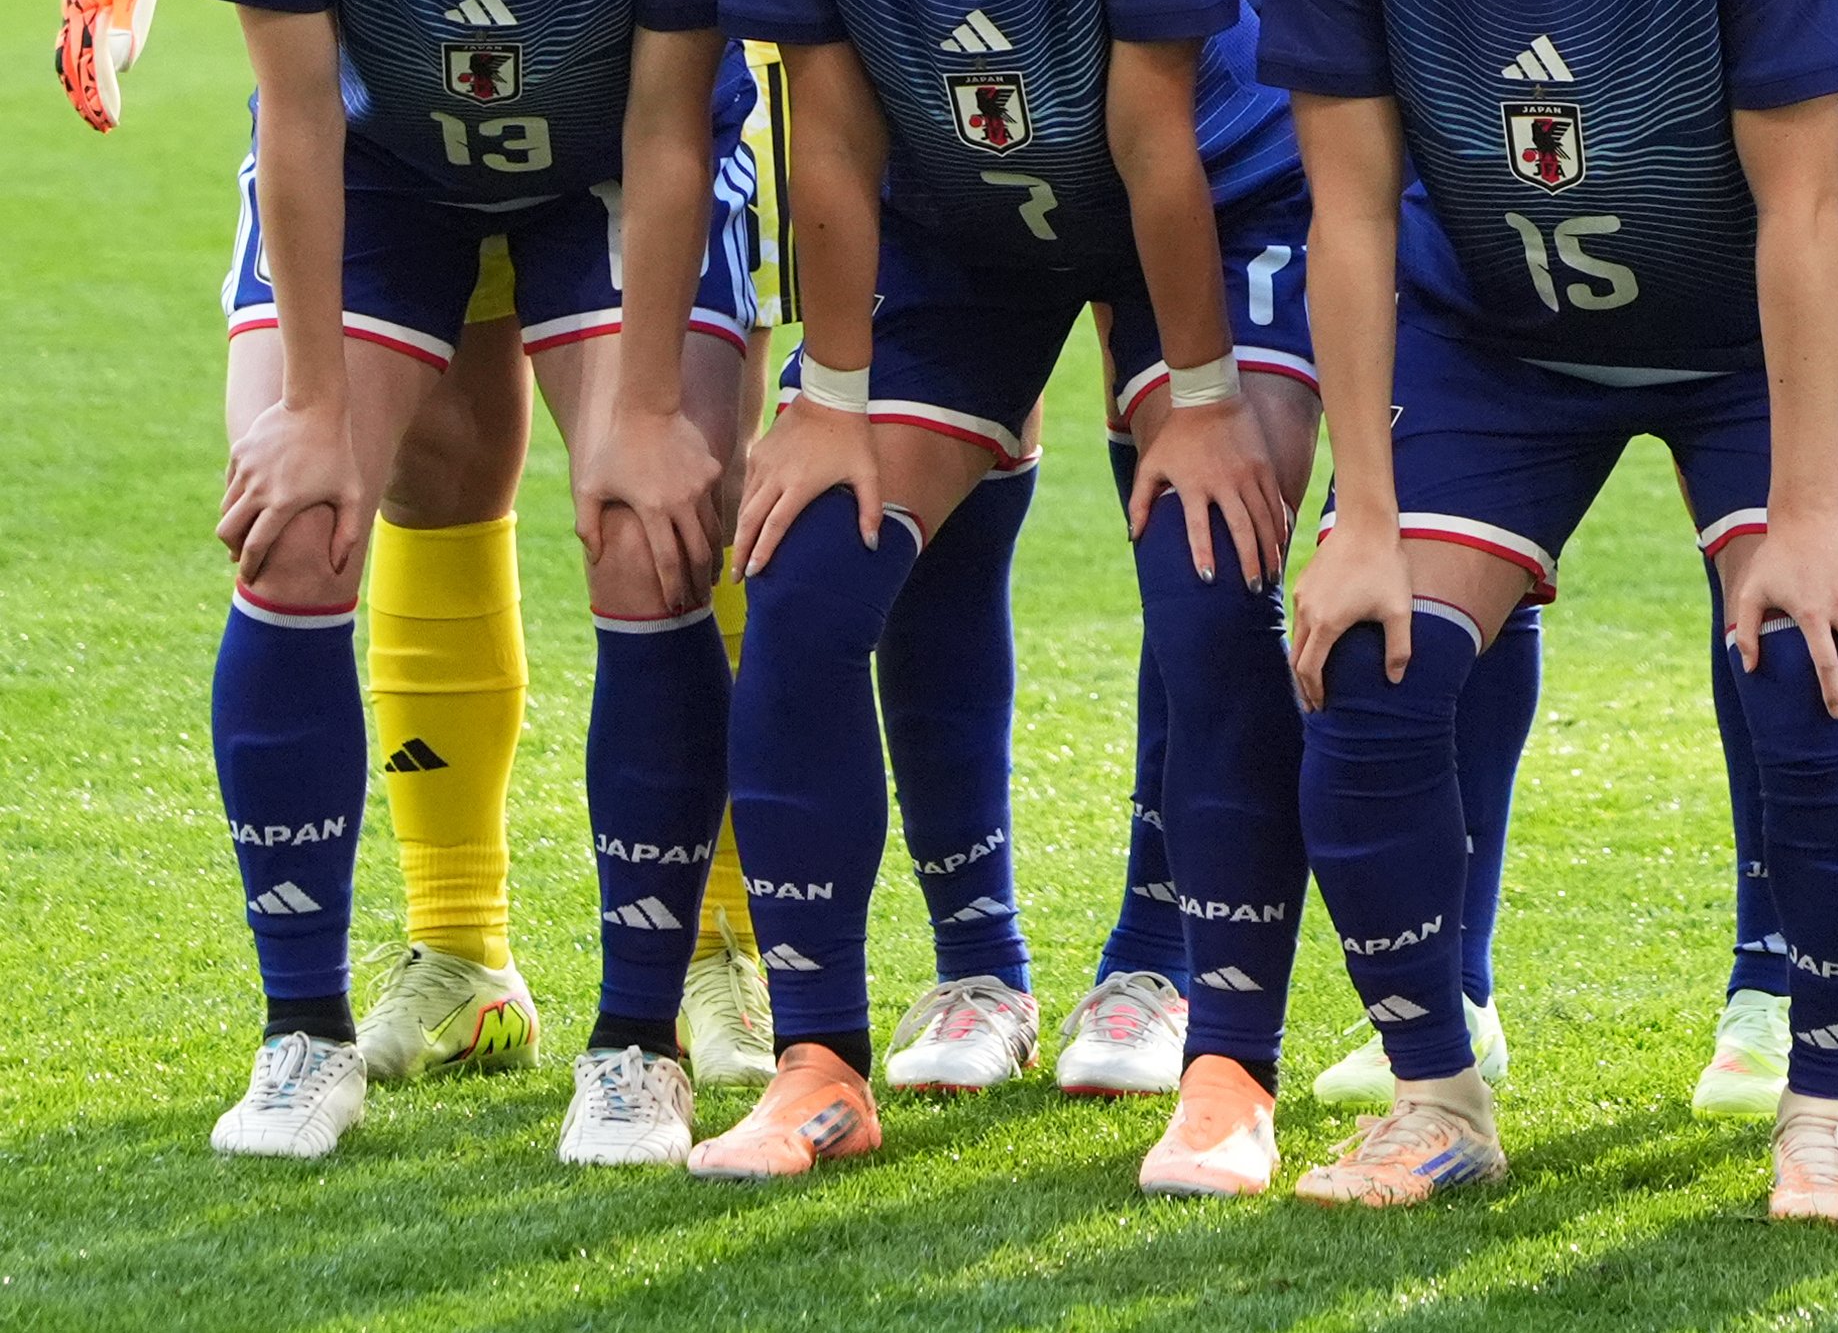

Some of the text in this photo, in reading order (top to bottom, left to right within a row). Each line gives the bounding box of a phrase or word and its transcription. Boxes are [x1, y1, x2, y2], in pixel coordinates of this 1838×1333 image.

[965, 76, 1004, 84] JAPAN
[1522, 105, 1562, 115] JAPAN
[430, 110, 553, 172] 13
[980, 171, 1057, 240] 7
[1505, 211, 1639, 312] 15
[229, 816, 347, 846] JAPAN
[595, 832, 713, 866] JAPAN
[1178, 894, 1286, 923] JAPAN
[1343, 915, 1442, 956] APAN
